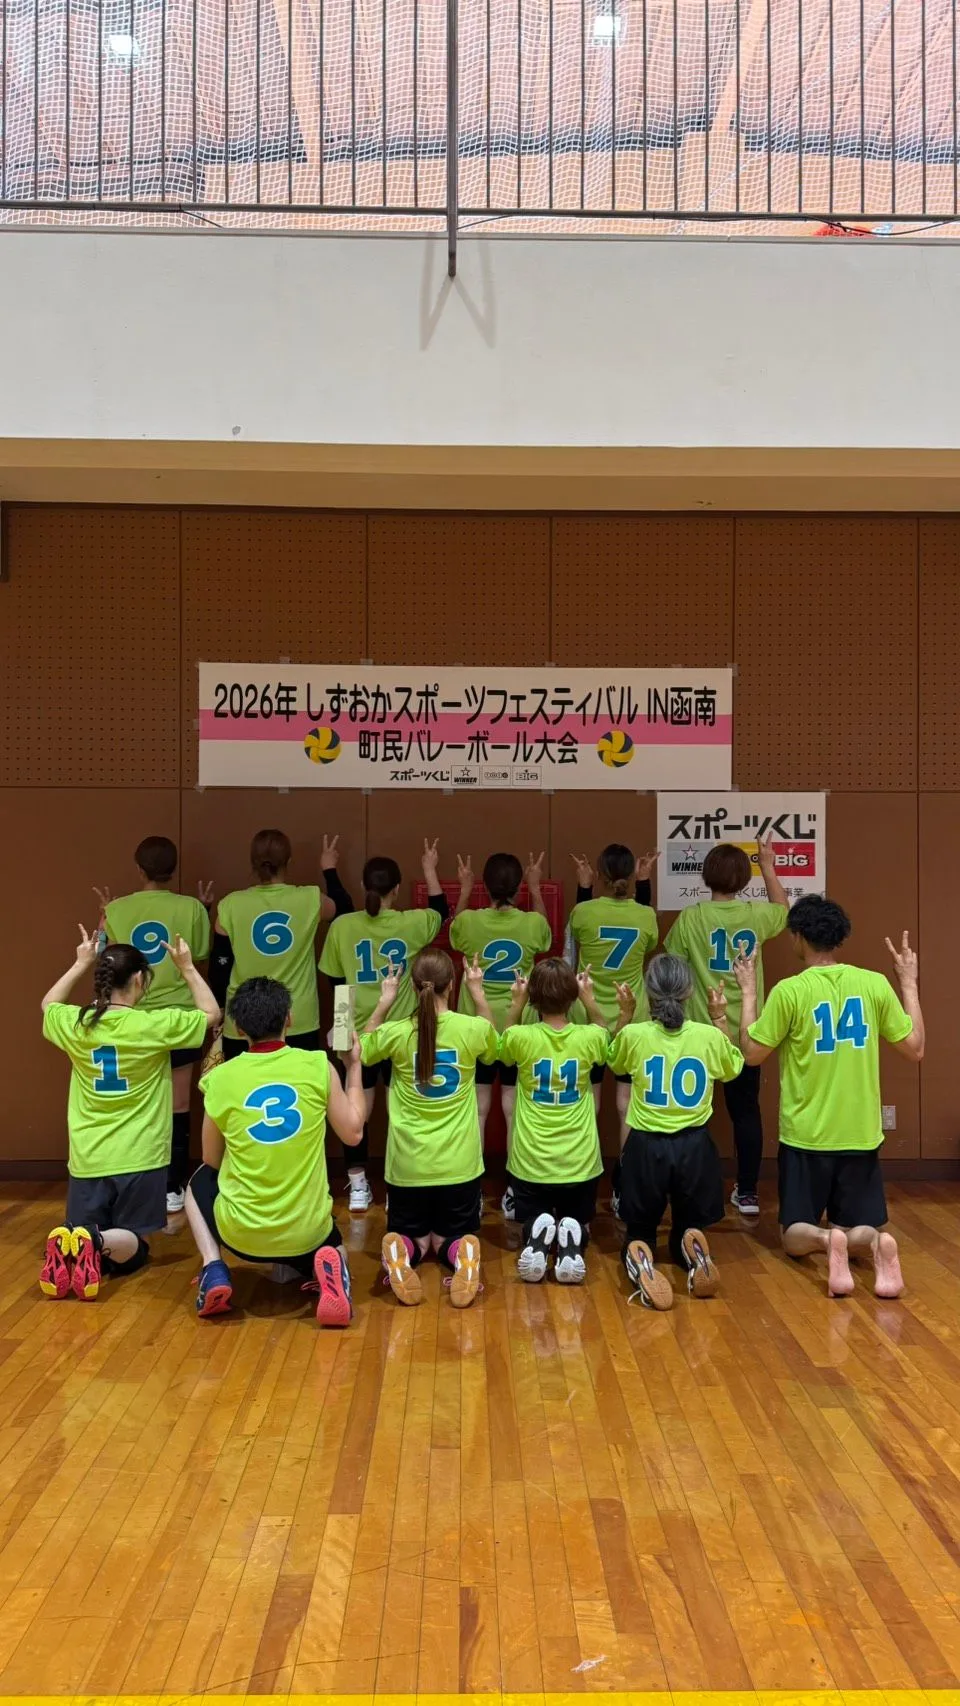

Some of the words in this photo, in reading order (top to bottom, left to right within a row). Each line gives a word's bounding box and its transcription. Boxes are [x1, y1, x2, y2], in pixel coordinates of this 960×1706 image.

[214, 682, 298, 722] 2026年
[306, 682, 639, 727] しずおかスポーツフェスティバル
[647, 685, 718, 728] IN函南
[358, 730, 579, 765] 町民バレーボール大会
[389, 767, 450, 782] スポーツくじ
[453, 776, 478, 784] WINNER
[667, 807, 817, 840] スポーツくじ
[671, 862, 704, 872] WINNE
[130, 920, 170, 966] 9
[251, 911, 294, 957] 6
[598, 927, 640, 970] 7
[355, 938, 408, 984] 13
[482, 938, 524, 983] 2
[812, 996, 870, 1054] 14
[91, 1045, 129, 1092] 1
[413, 1048, 462, 1100] 5
[530, 1058, 581, 1106] 11
[644, 1054, 708, 1110] 10
[243, 1082, 303, 1145] 3
